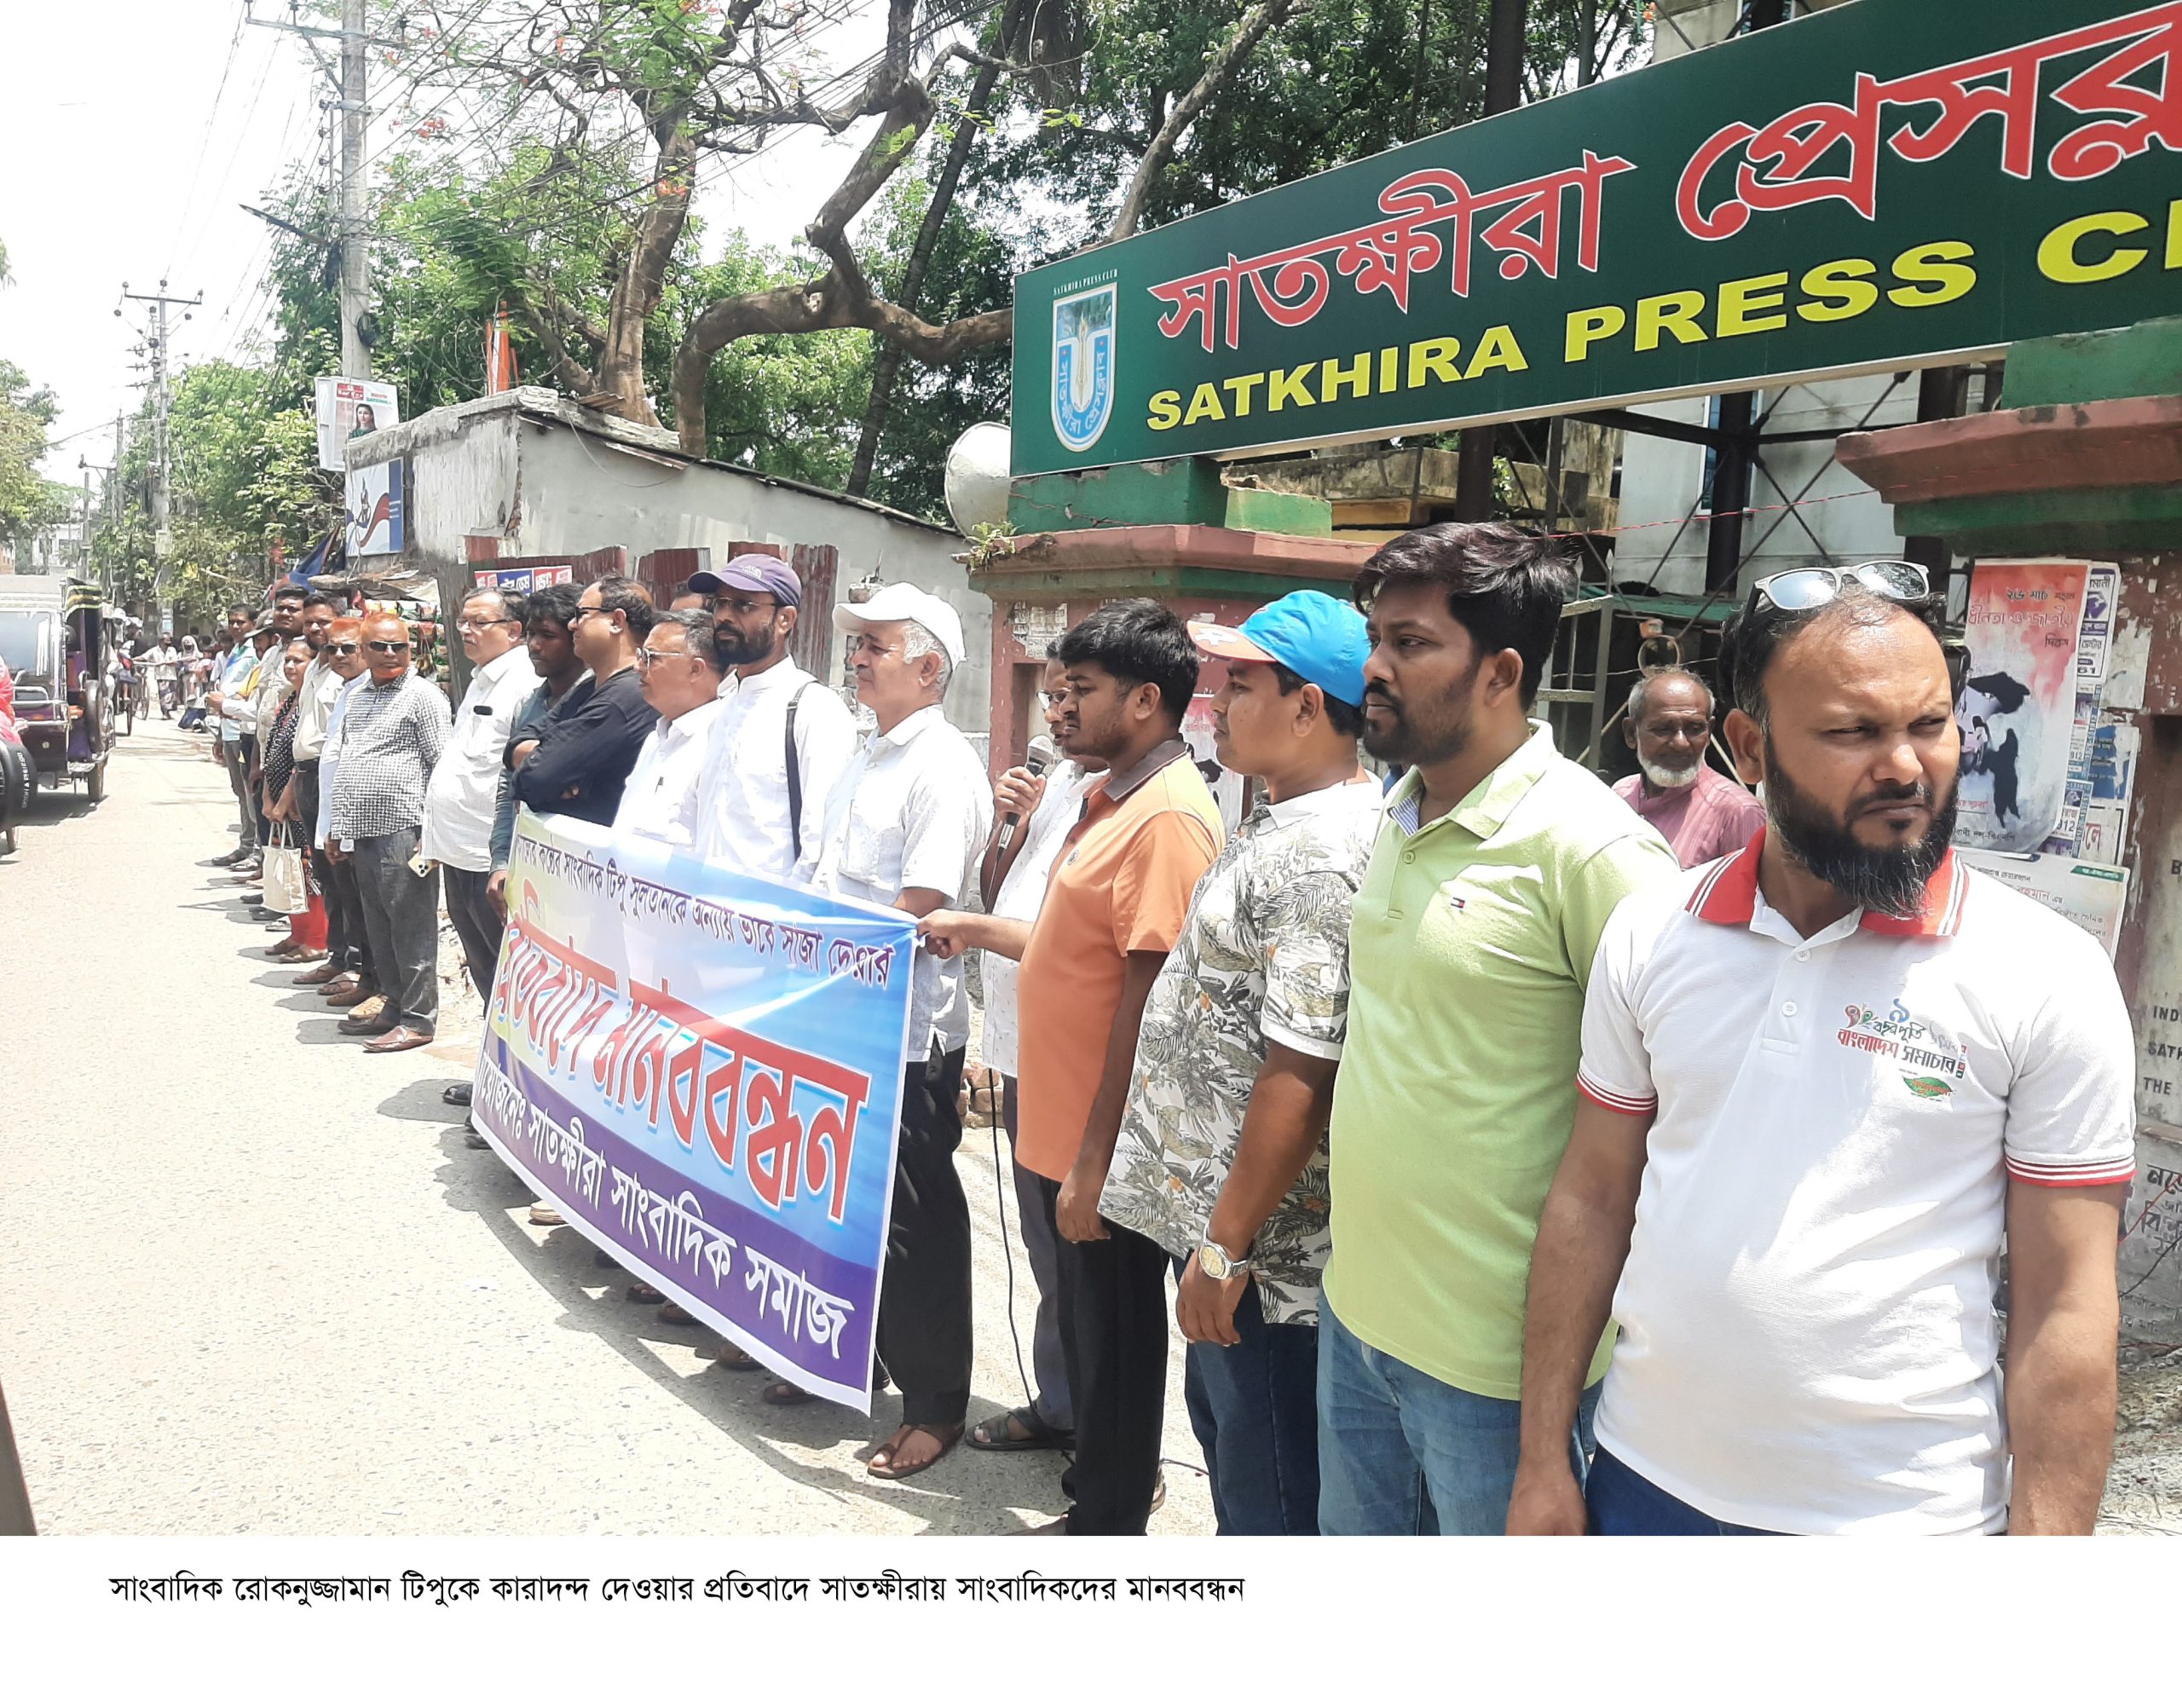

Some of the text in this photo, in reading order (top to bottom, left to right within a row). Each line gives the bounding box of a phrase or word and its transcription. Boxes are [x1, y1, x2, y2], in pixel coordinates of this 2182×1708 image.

[1148, 199, 2182, 430] SATKHIRA PRESS C
[1151, 148, 1635, 354] সাতক্ষীরা
[563, 849, 604, 895] সাংবাদিক
[605, 857, 628, 917] টিপু
[630, 876, 693, 926] সুলতানকে
[738, 913, 776, 961] ভাবে
[779, 919, 824, 972] সাজা
[592, 976, 872, 1226] মানববন্ধন
[1837, 1028, 1956, 1075] বাংলাদেশ সমাচার
[2143, 1076, 2173, 1095] THE
[528, 1103, 608, 1212] সাতক্ষীরা
[611, 1168, 736, 1290] সাংবাদিক
[743, 1243, 855, 1361] সমাজ
